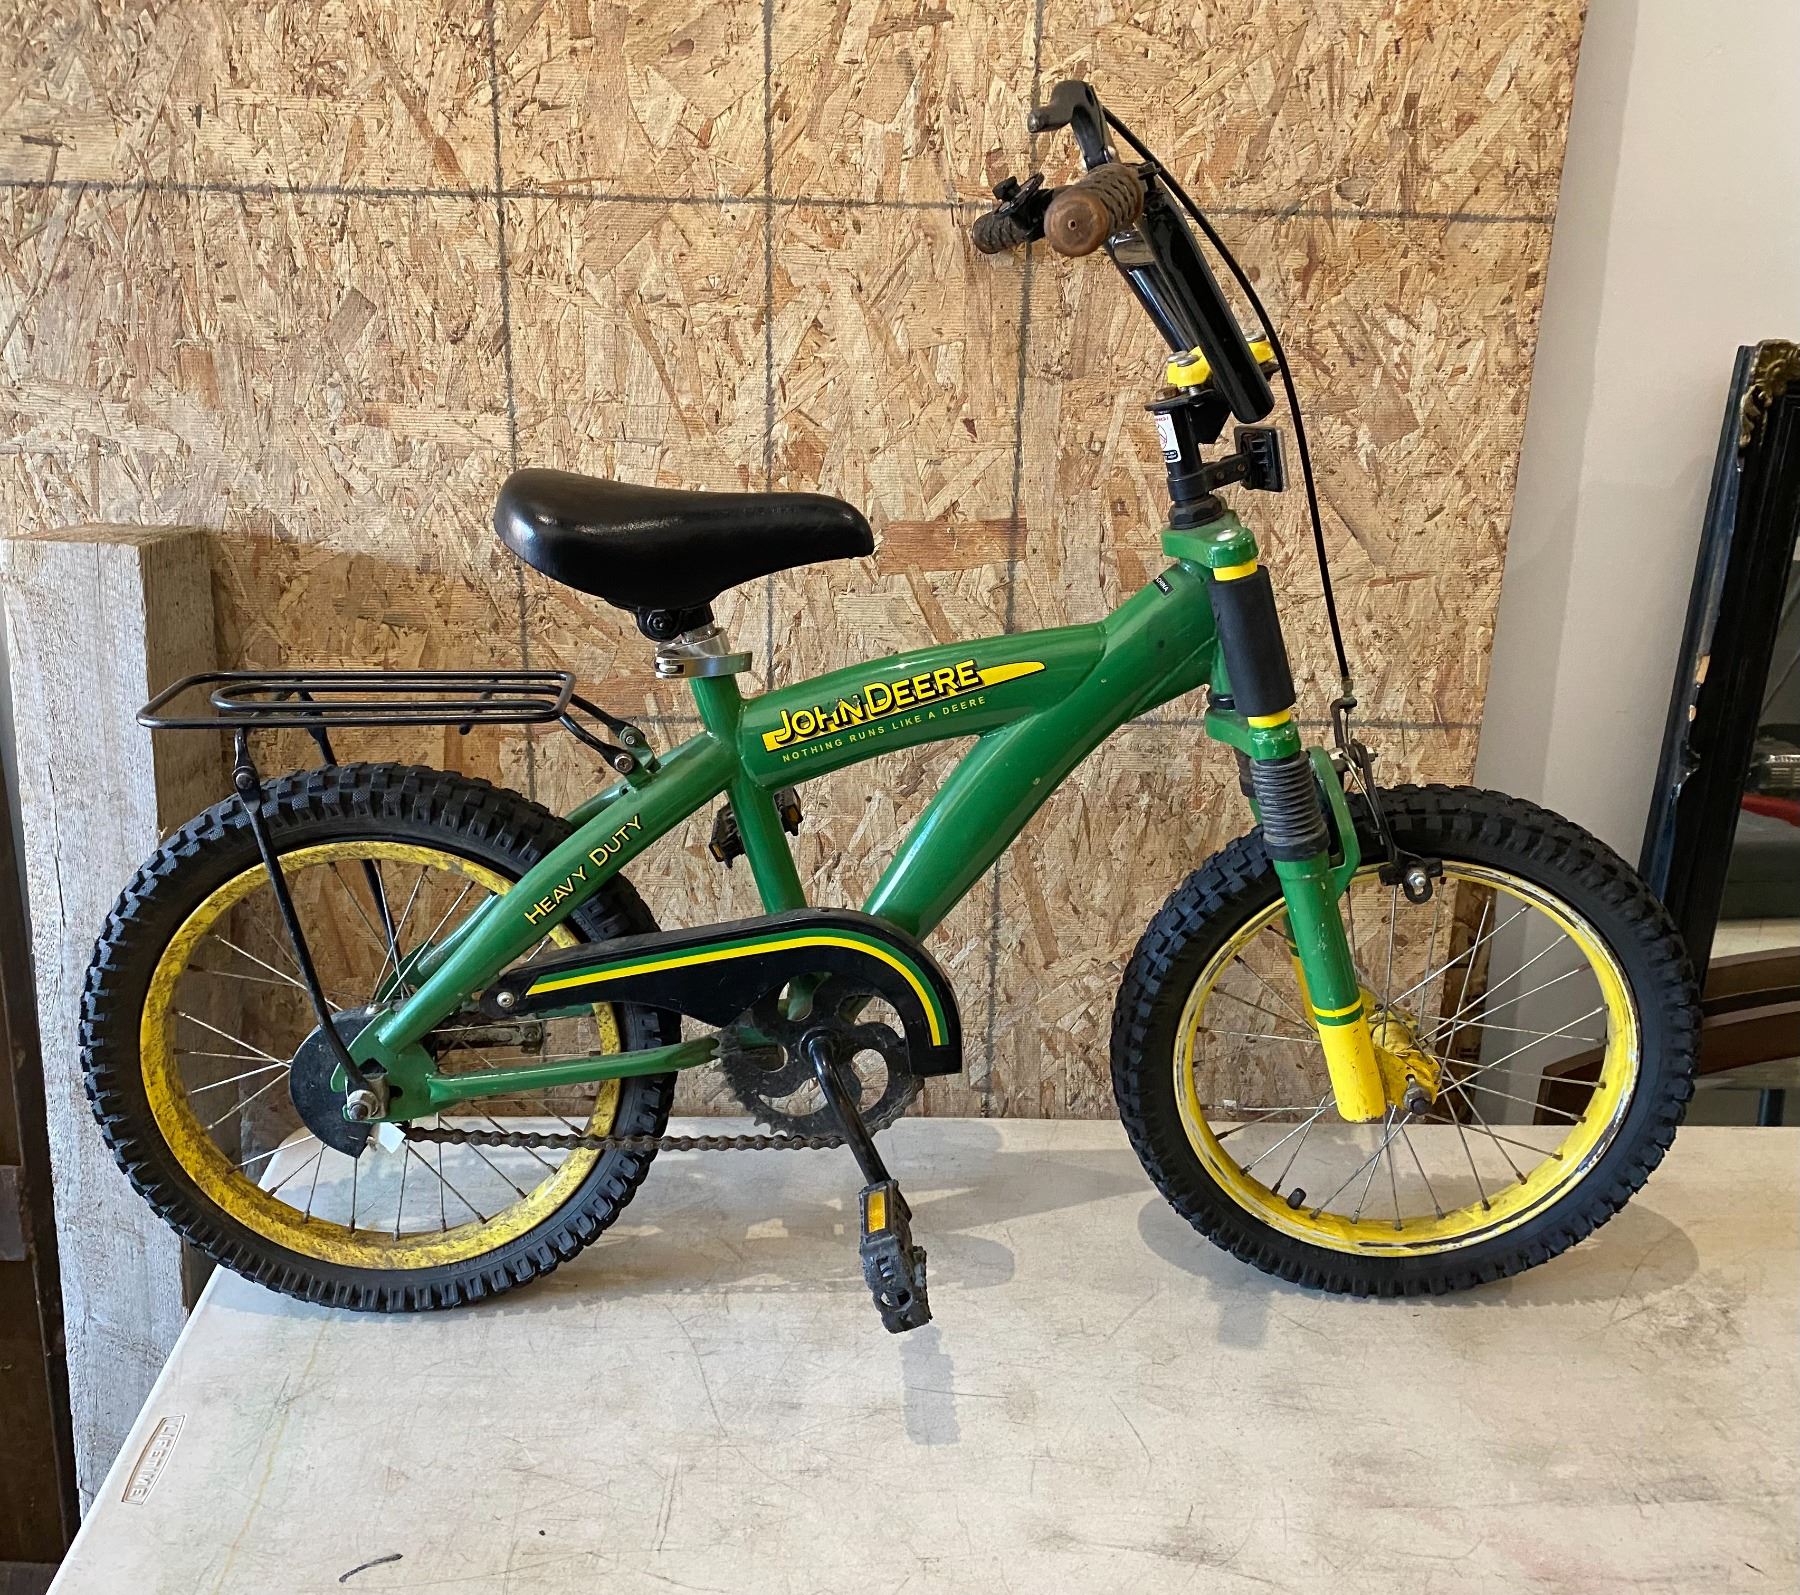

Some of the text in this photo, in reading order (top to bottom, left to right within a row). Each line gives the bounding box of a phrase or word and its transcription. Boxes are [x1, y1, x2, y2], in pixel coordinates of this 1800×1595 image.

[774, 659, 981, 744] JOHN DEERE
[782, 695, 986, 763] NOTHING RUNS LIKE A DEERE
[523, 813, 643, 926] HEAVY DUTY
[129, 1423, 180, 1498] LIFETIME
